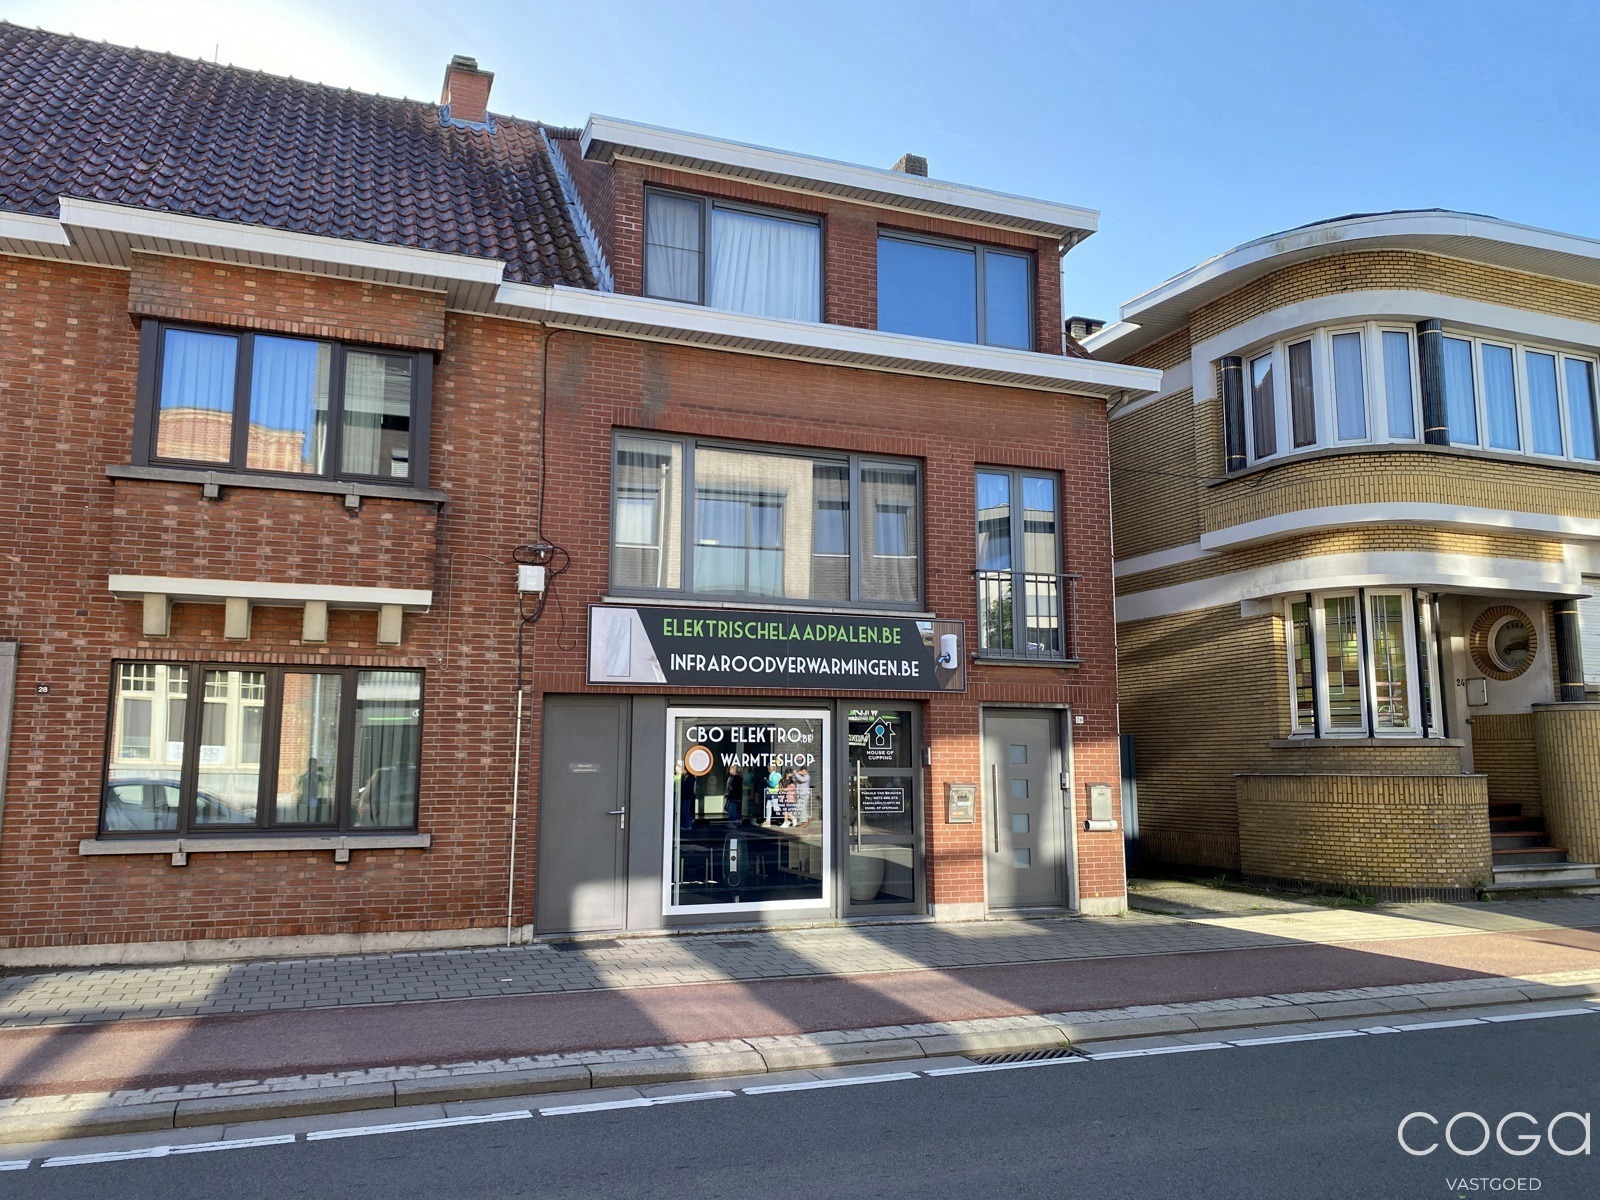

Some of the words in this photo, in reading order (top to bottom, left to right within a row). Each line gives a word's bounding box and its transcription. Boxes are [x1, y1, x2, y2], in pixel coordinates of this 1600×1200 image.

[662, 618, 902, 645] ELEKTRISCHELAADPALEN.BE
[669, 653, 920, 678] INFRAROODVERWARMINGEN.BE
[1456, 678, 1466, 687] 24
[686, 726, 724, 743] CBO
[720, 753, 815, 767] WARMTESHOP
